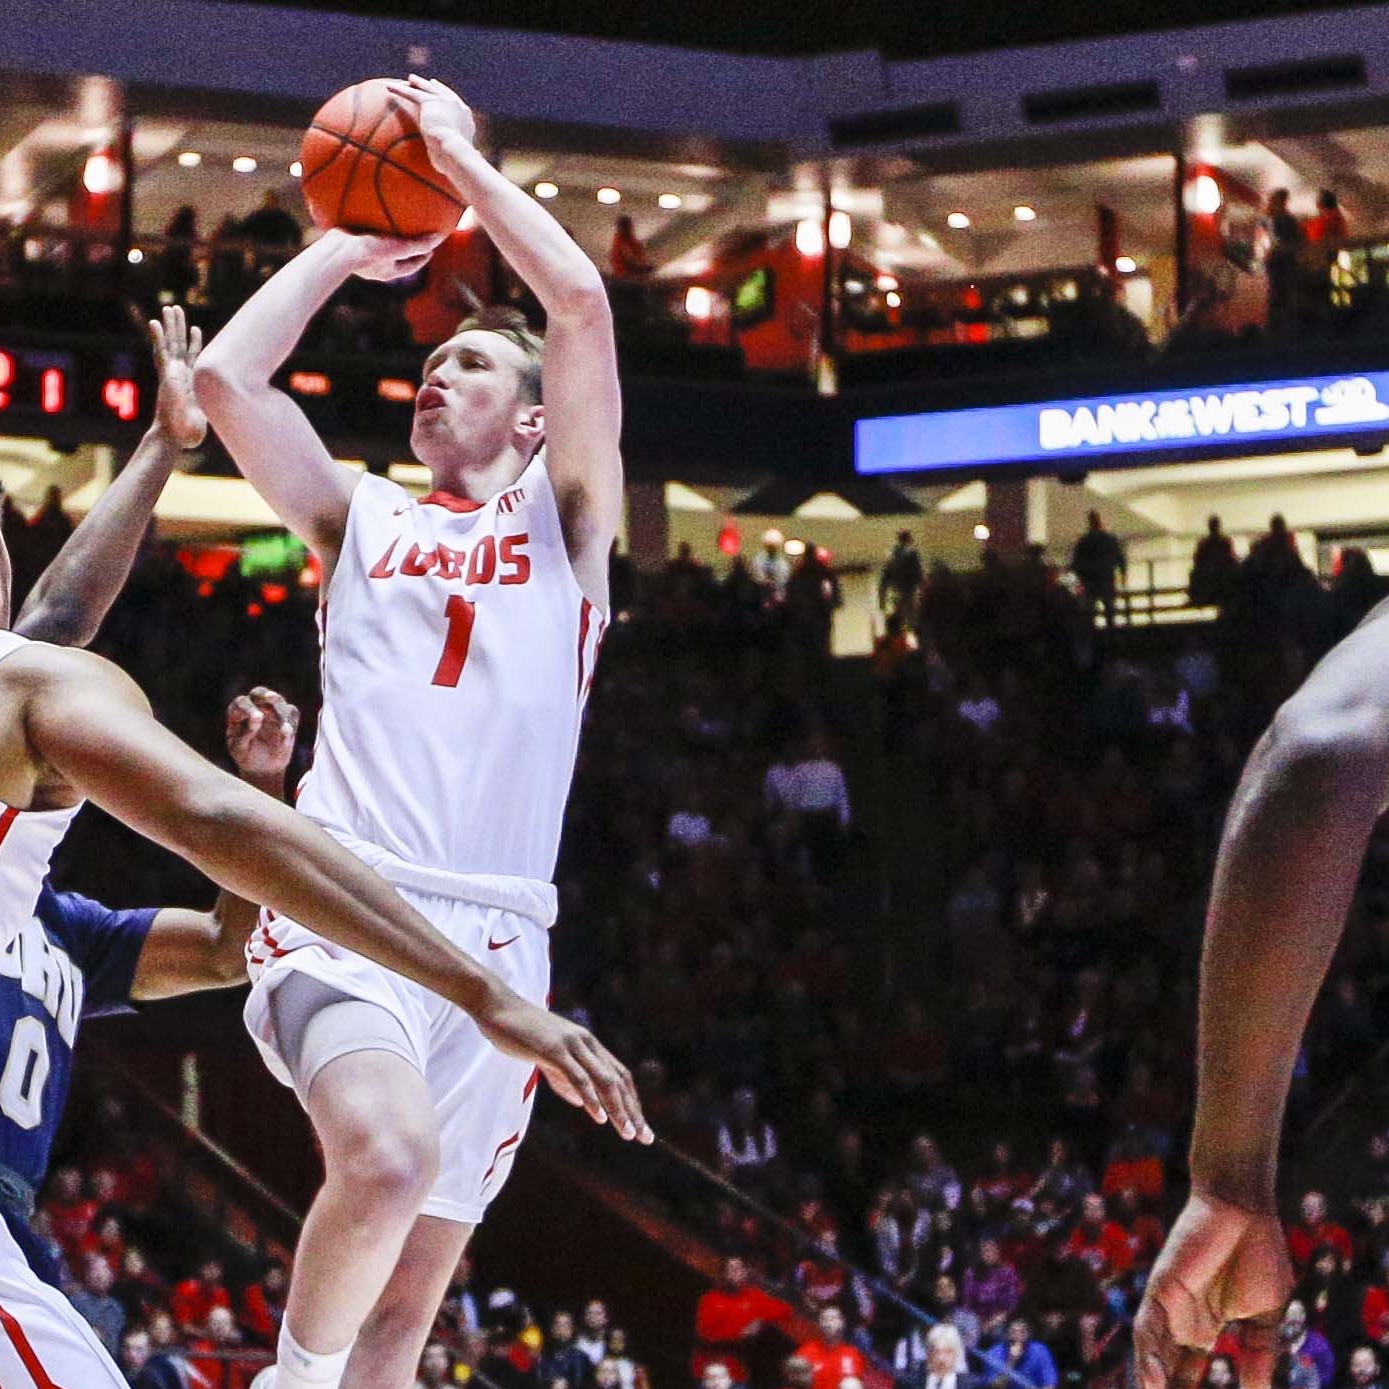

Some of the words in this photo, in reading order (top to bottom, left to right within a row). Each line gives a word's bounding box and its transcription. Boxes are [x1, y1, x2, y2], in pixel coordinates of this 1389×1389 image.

[1038, 402, 1158, 450] BANK
[1189, 385, 1319, 437] WEST
[368, 532, 532, 586] LOBOS
[430, 593, 476, 689] 1
